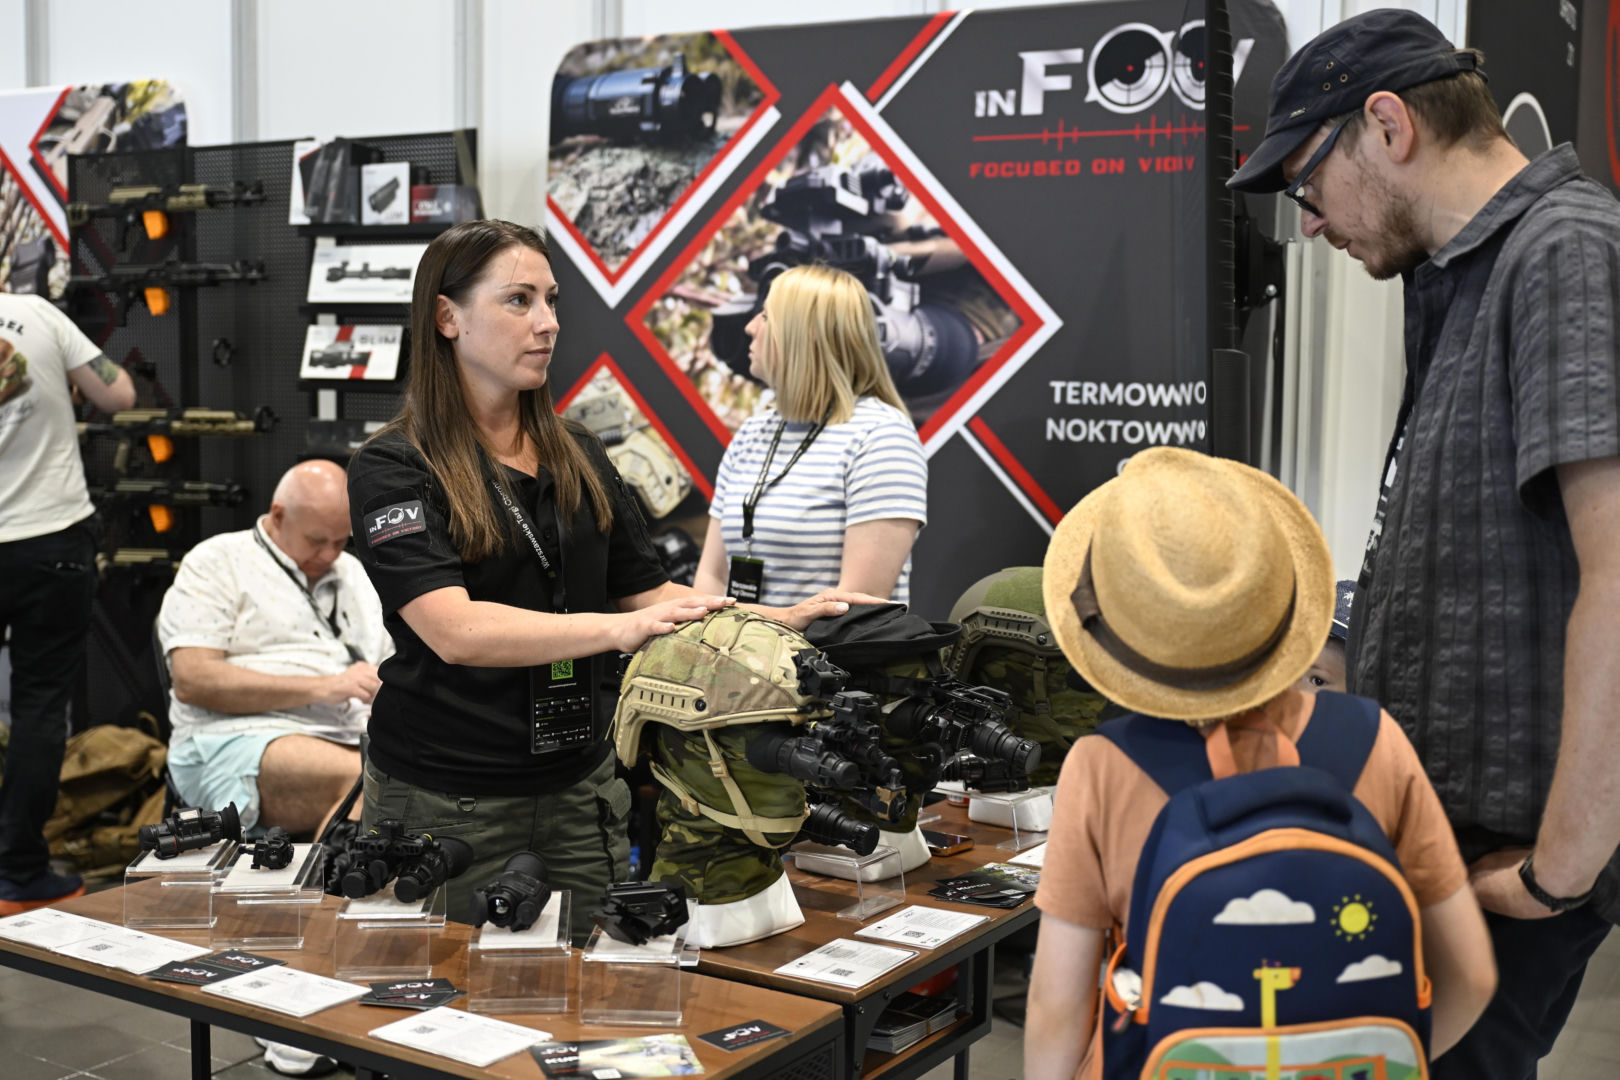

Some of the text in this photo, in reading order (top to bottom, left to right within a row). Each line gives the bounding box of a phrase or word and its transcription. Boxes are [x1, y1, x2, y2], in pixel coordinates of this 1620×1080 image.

[969, 158, 1081, 179] FOCUSED
[1091, 157, 1125, 175] ON
[508, 505, 524, 525] Targi
